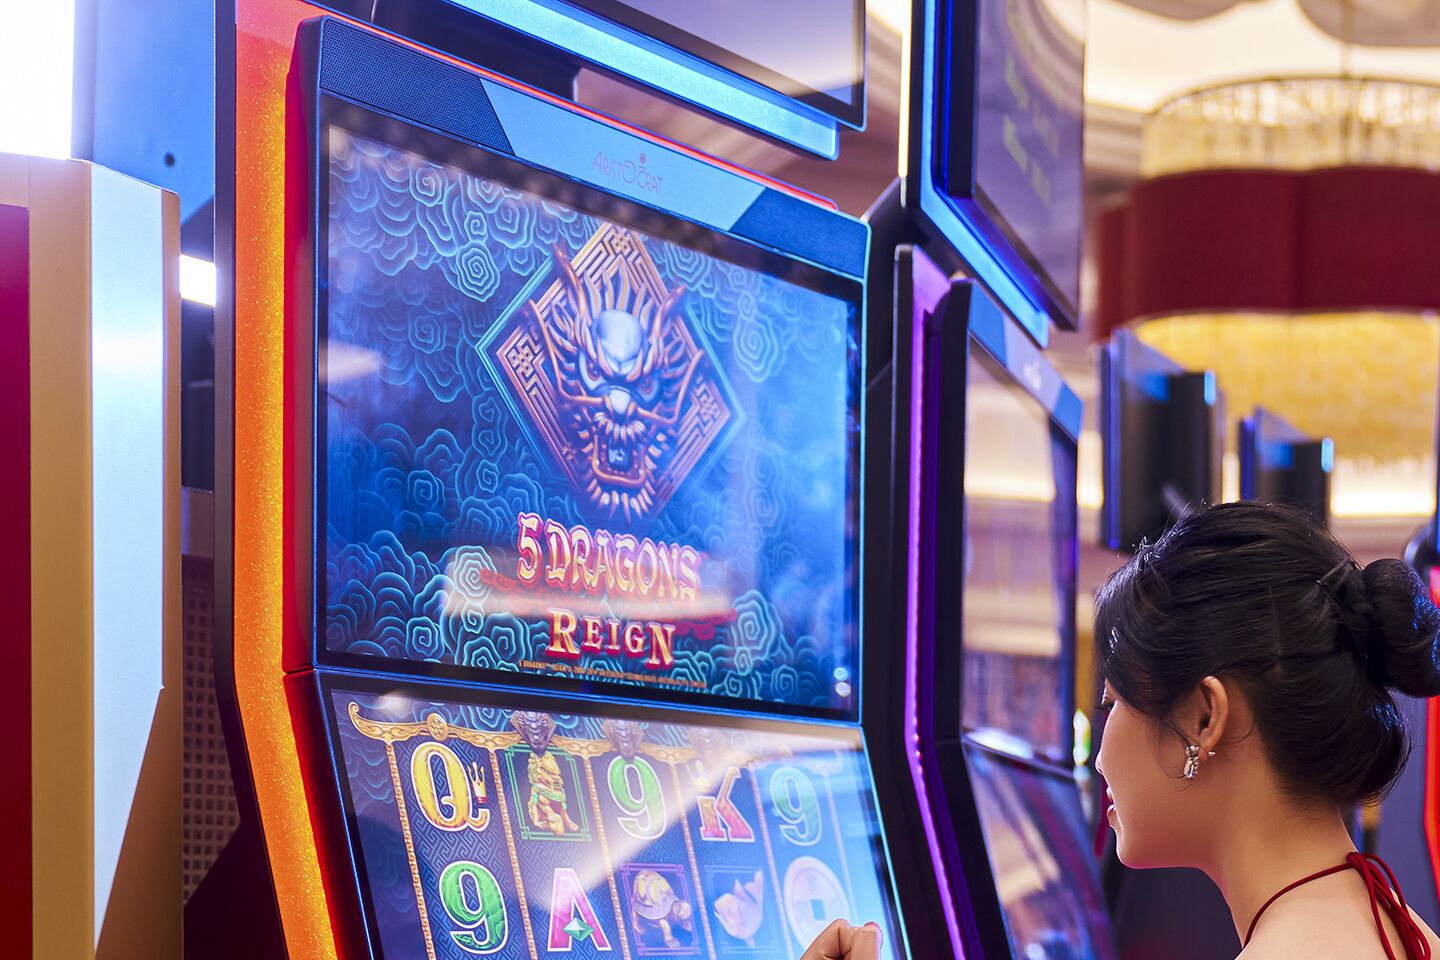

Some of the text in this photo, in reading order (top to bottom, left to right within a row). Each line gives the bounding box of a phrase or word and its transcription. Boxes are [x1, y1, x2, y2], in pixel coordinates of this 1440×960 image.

[517, 511, 702, 601] 5 DRAGONS
[545, 607, 677, 668] REIGN
[411, 741, 490, 832] Q
[607, 755, 667, 840] 9
[697, 766, 756, 843] K
[769, 766, 823, 847] 9
[439, 860, 508, 954] 9
[547, 867, 612, 951] A
